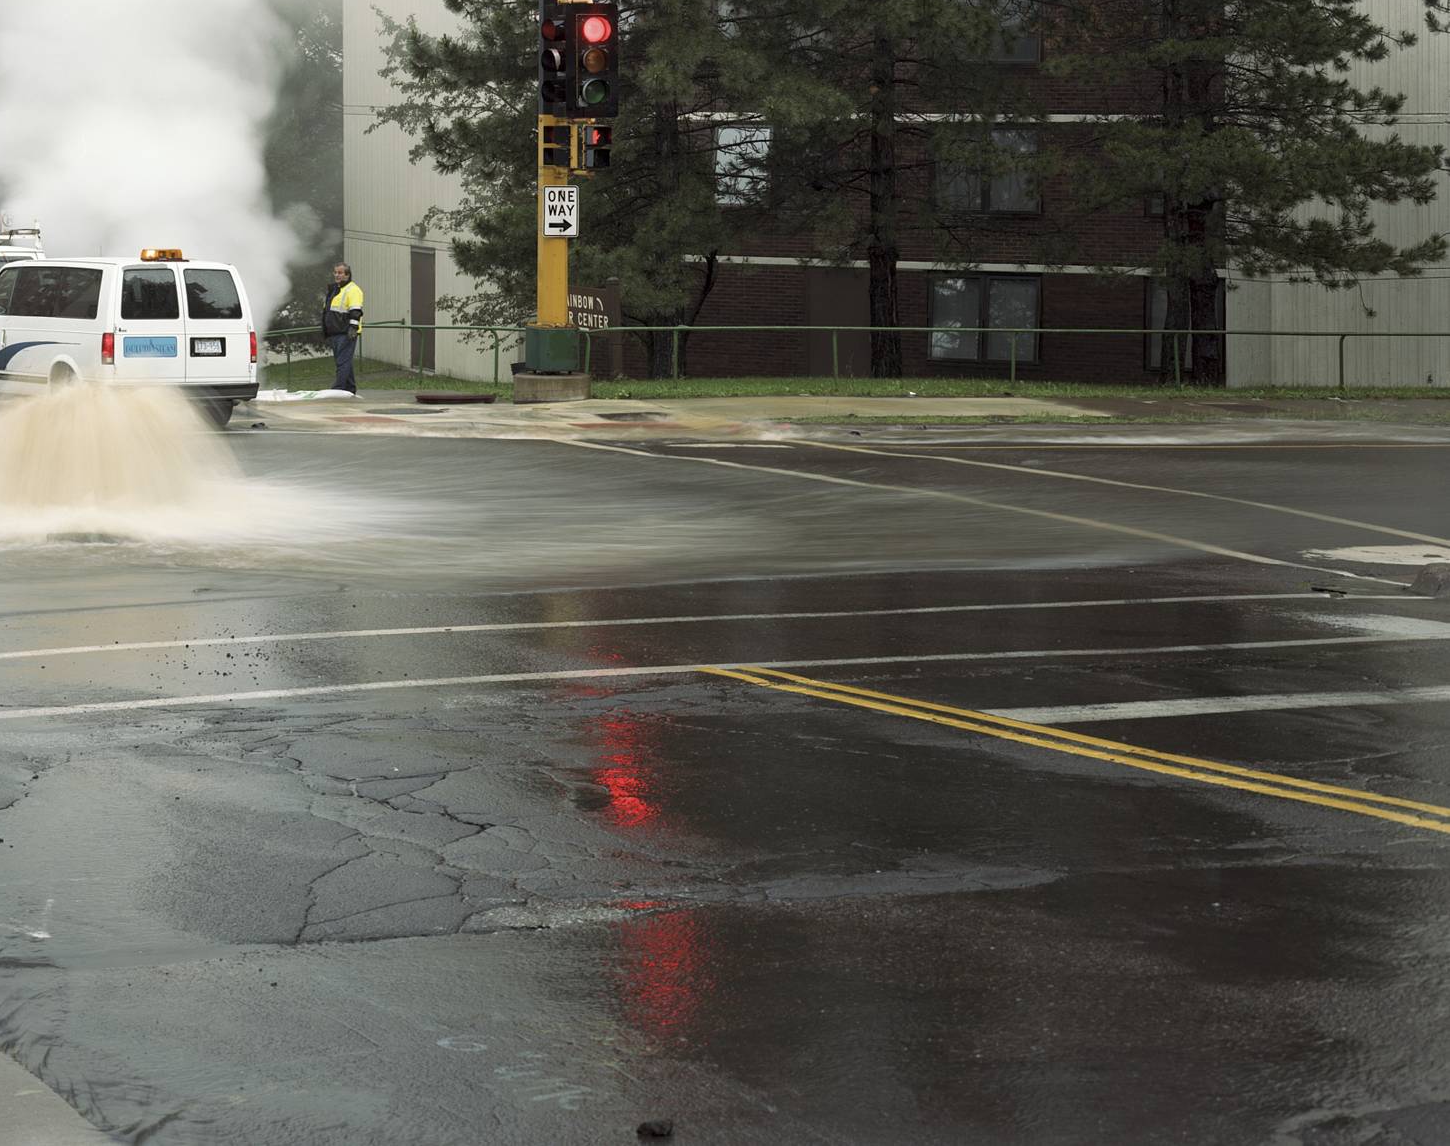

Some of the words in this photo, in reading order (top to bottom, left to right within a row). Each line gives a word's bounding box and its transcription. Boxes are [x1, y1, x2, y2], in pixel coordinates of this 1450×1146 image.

[548, 190, 575, 202] ONE
[548, 205, 575, 216] WAY
[578, 312, 609, 329] CENTER
